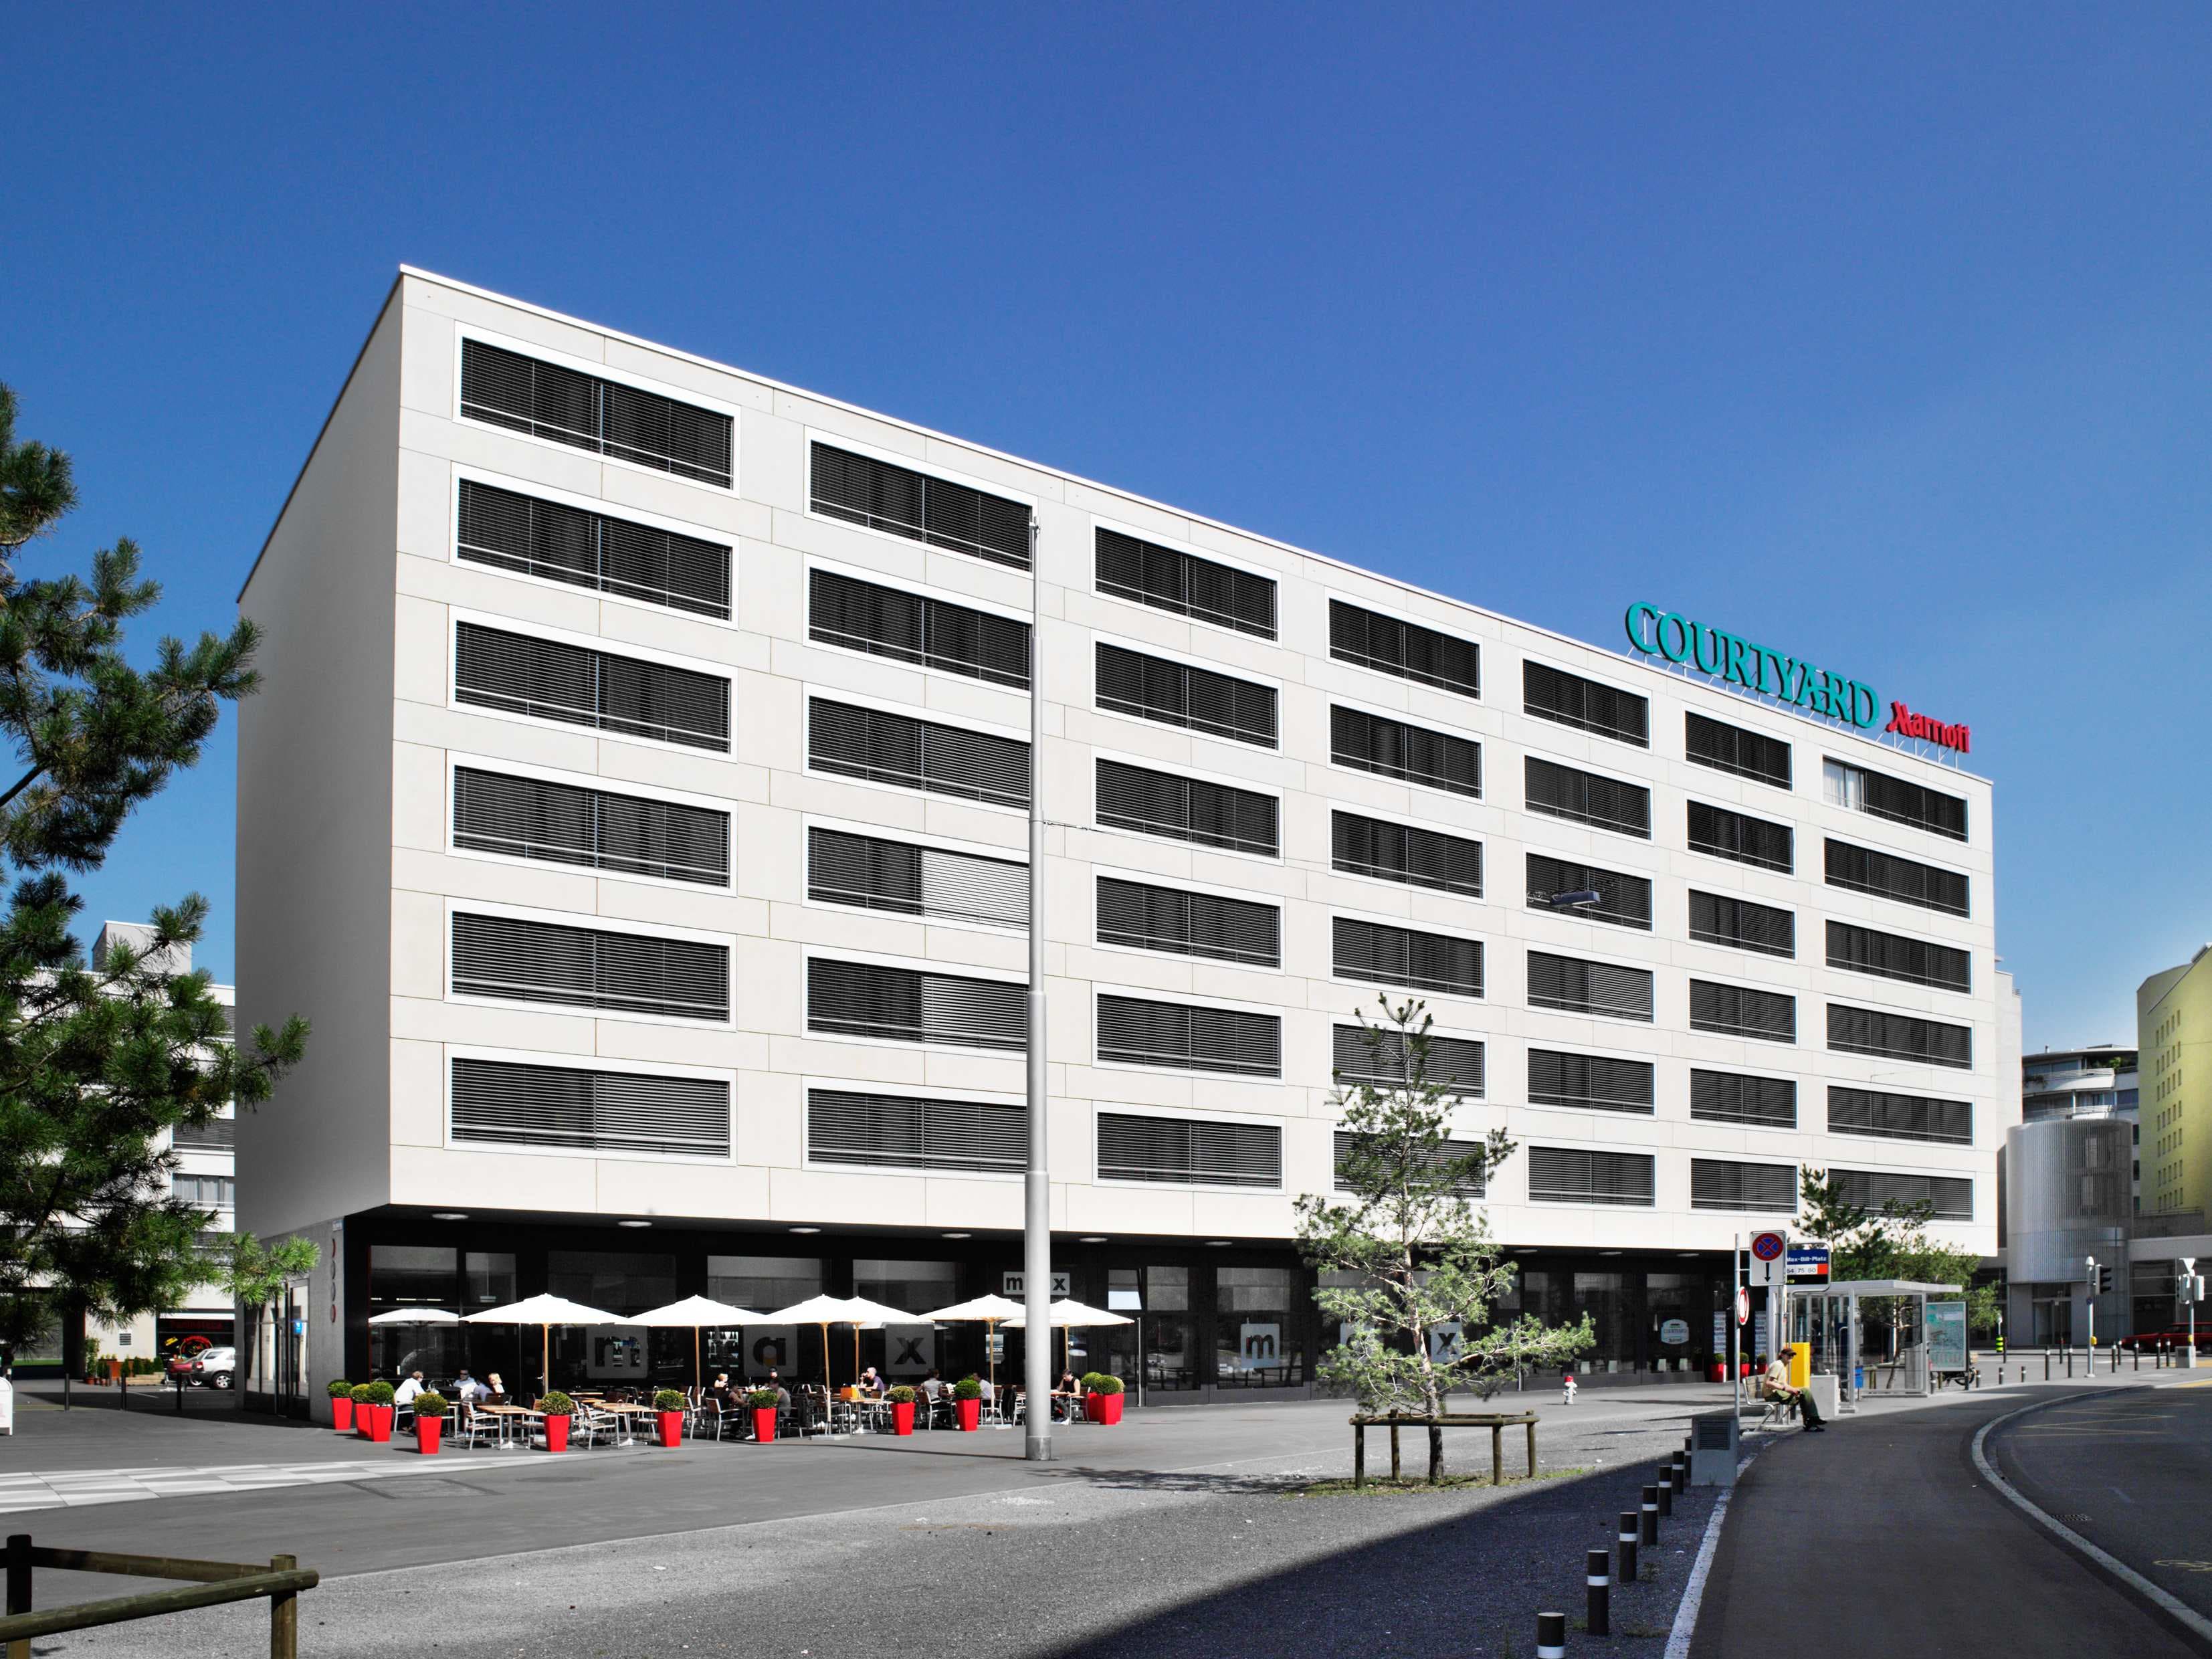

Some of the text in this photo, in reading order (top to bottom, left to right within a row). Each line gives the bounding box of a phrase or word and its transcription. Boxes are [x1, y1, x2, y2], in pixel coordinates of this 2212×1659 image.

[1625, 601, 1970, 753] COURTYARD Marriott
[1006, 1278, 1066, 1290] mx
